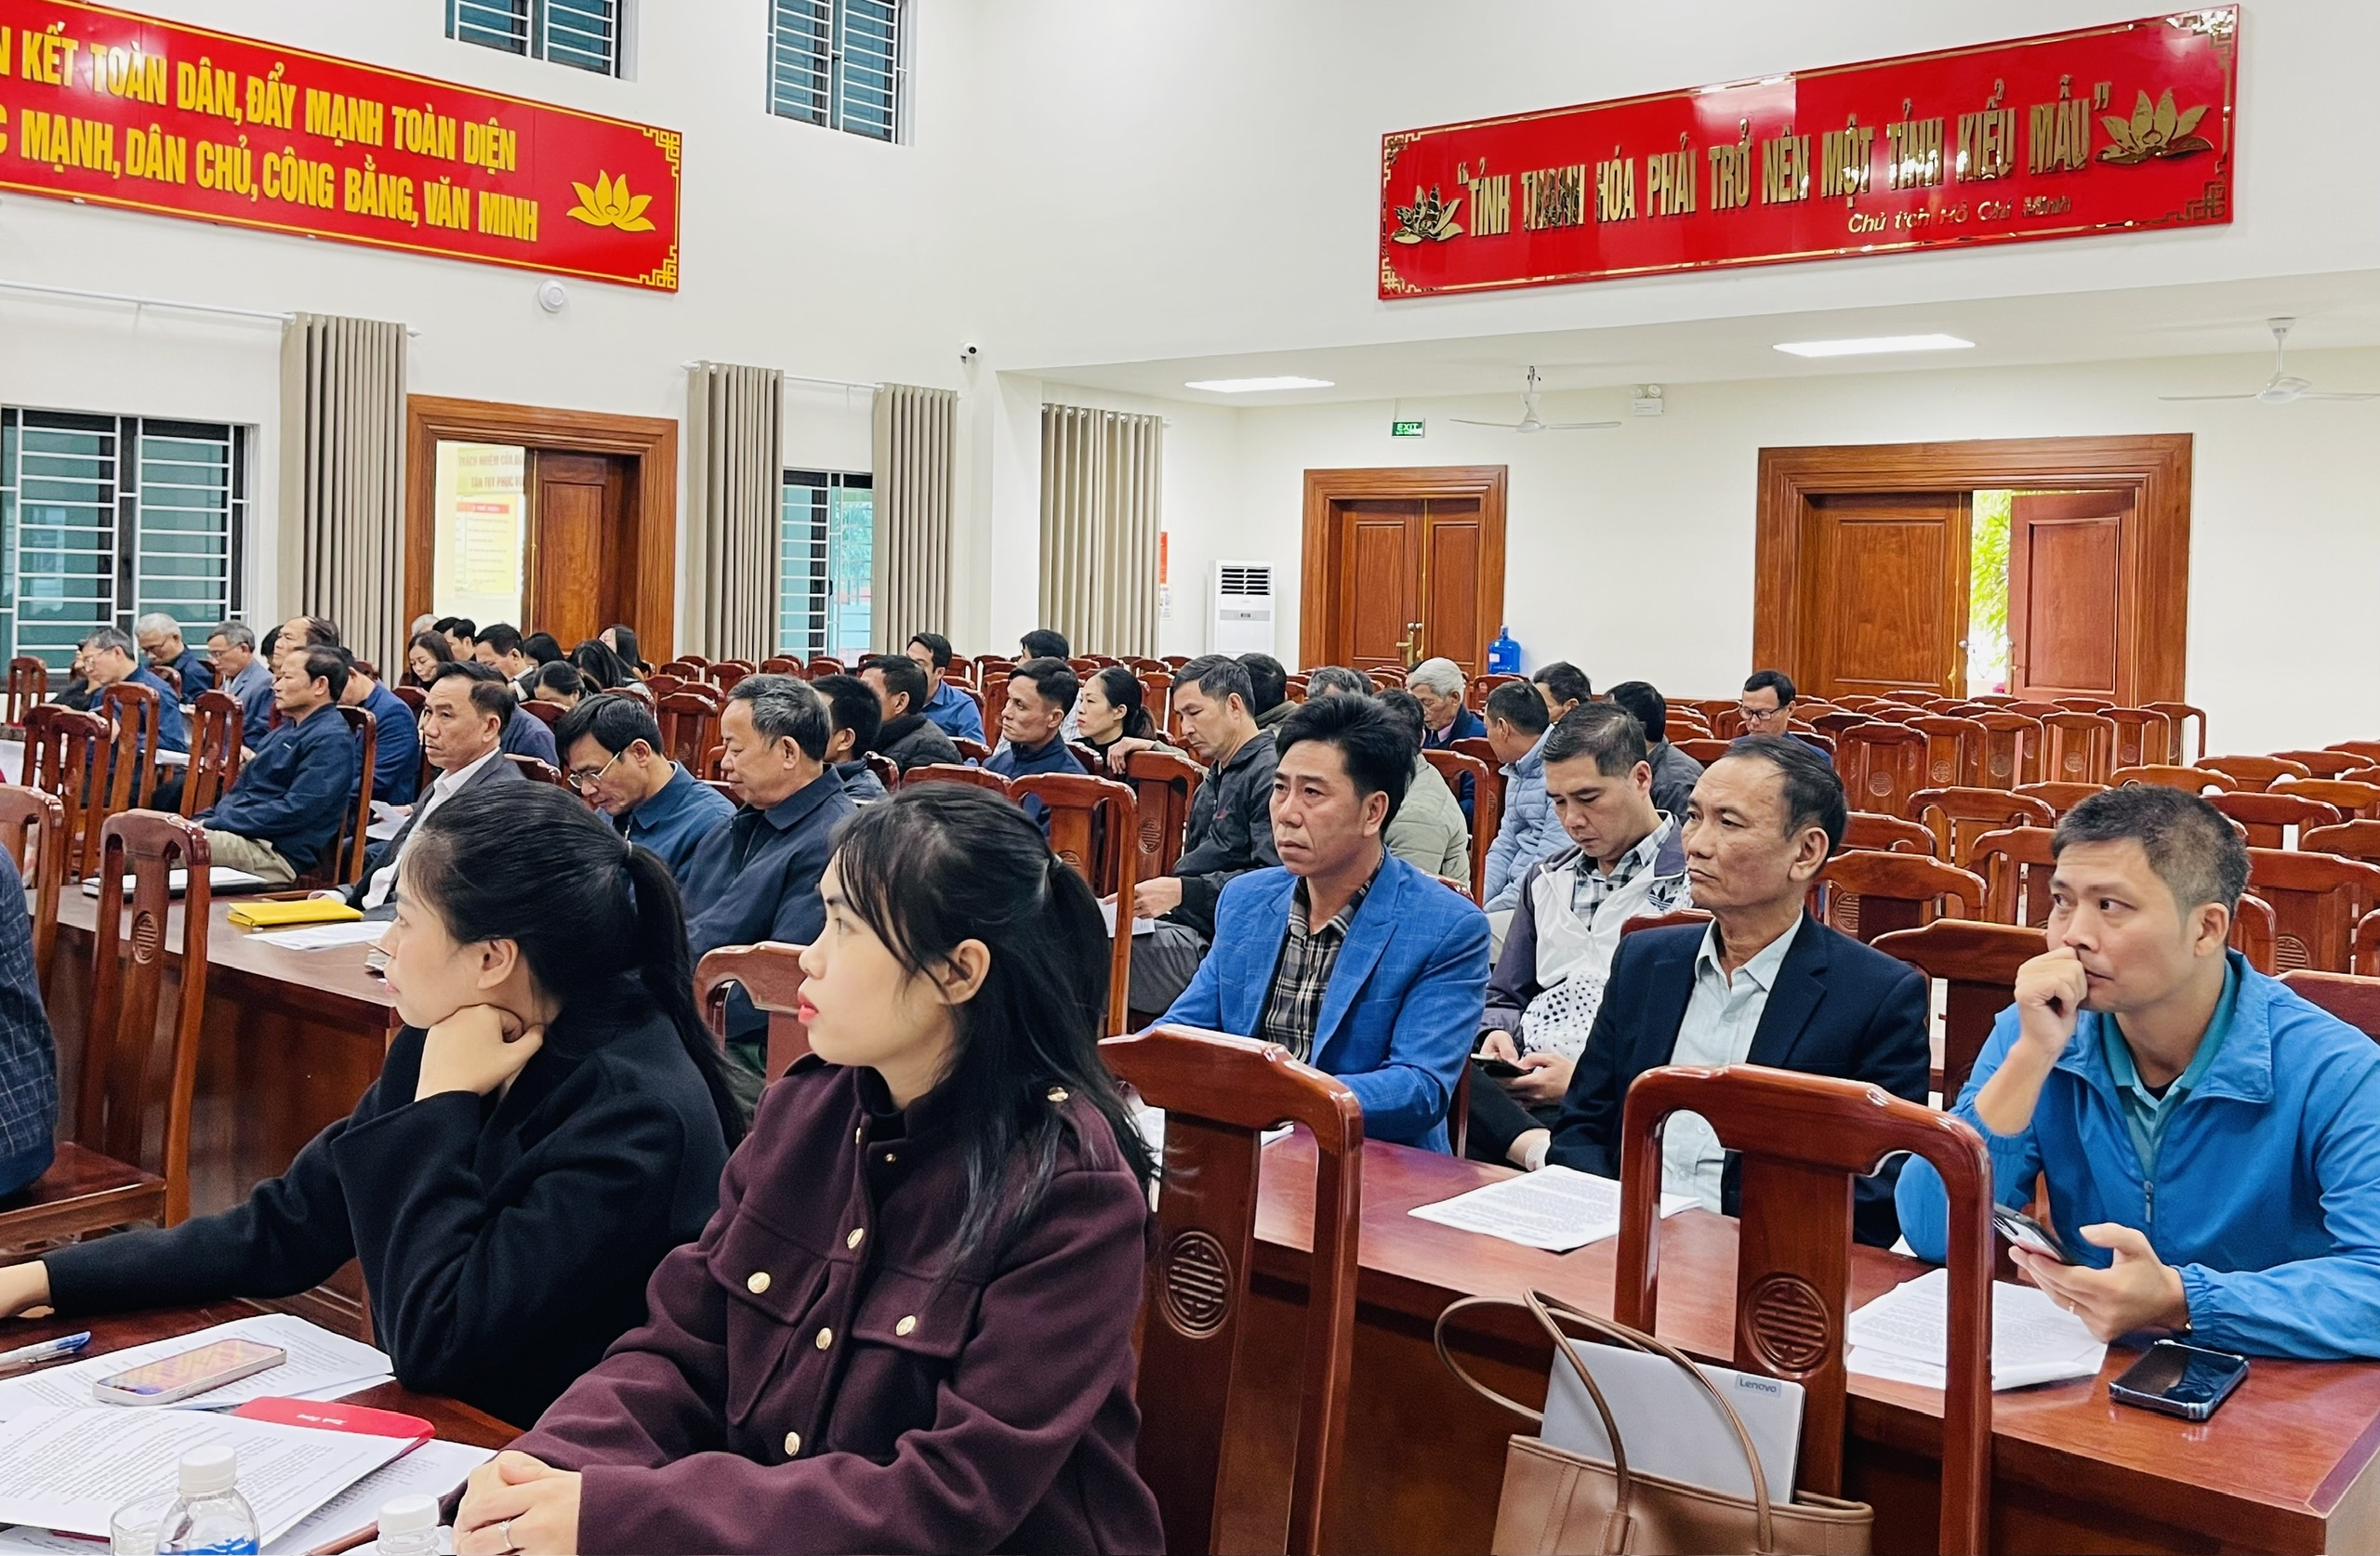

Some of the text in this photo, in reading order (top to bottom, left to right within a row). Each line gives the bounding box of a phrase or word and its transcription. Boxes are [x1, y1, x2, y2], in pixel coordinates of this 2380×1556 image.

[21, 20, 79, 87] KẾT
[89, 40, 167, 106] TOÀN
[177, 56, 243, 126] DÂN,
[245, 61, 297, 130] ĐẨY
[305, 87, 384, 149] MẠNH
[391, 102, 456, 161] TOÀN
[463, 116, 516, 176] DIỆN
[20, 109, 121, 180] MẠNH,
[126, 123, 187, 185] DÂN
[195, 134, 258, 203] CHỦ,
[262, 145, 336, 210] CÔNG
[344, 153, 419, 229] BẰNG,
[423, 175, 470, 231] VĂN
[478, 190, 539, 243] MINH
[1595, 144, 1637, 223] HÓA
[1646, 131, 1698, 218] PHẢI
[1707, 117, 1753, 211] TRỞ
[1762, 125, 1811, 204] NÊN
[1821, 112, 1875, 209] MỘT
[1885, 97, 1945, 191] TỈNH
[1956, 77, 2017, 183] KIỂU
[1847, 212, 1887, 233] Chủ
[1977, 198, 2014, 221] Chí
[2022, 193, 2072, 218] Minh
[1396, 423, 1419, 431] EXIT
[1739, 1378, 1777, 1393] Lenovo
